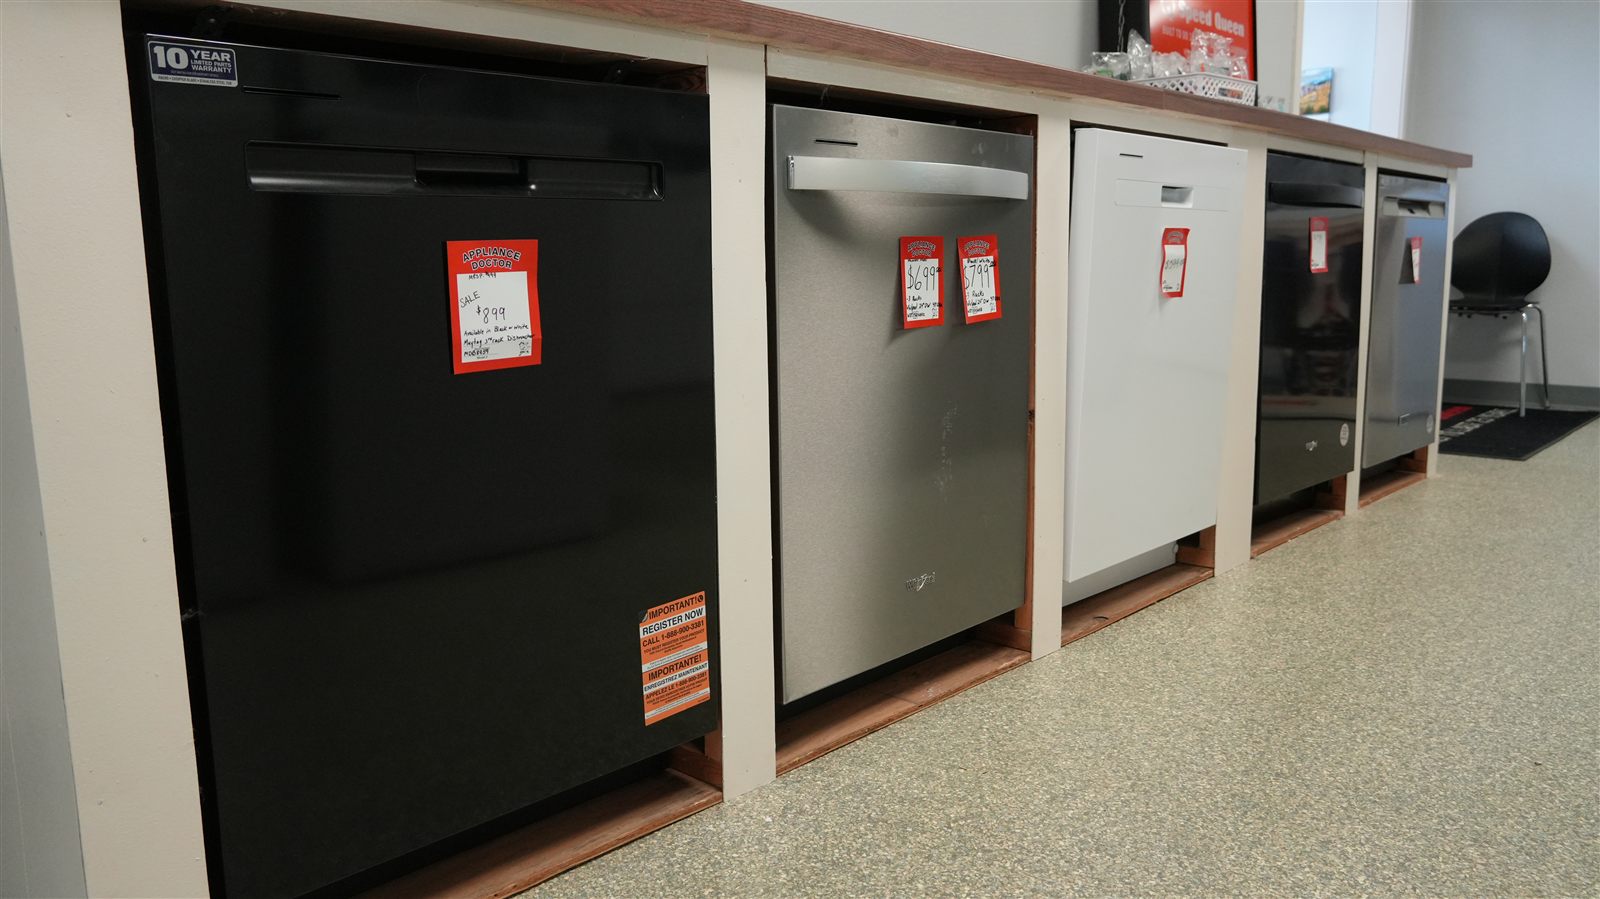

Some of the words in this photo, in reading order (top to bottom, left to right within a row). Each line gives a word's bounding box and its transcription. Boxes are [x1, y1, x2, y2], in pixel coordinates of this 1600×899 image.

[1214, 11, 1245, 38] Queen
[153, 45, 189, 70] 10
[190, 49, 231, 62] YEAR
[190, 59, 213, 67] LIMITED
[191, 64, 232, 74] WARRANTY
[907, 240, 937, 253] APPLIANCE
[463, 246, 521, 263] APPLIANCE
[471, 258, 512, 270] DOCTOR
[460, 290, 480, 308] SALE
[476, 304, 506, 324] $899
[494, 325, 508, 333] Black
[464, 338, 482, 348] Maytag
[648, 595, 697, 620] IMPORTANT!
[642, 615, 683, 636] REGISTER
[684, 607, 704, 621] NOW
[642, 636, 659, 647] CALL
[648, 653, 702, 681] IMPORTANTE!
[644, 674, 678, 692] ENREGISTREZ
[677, 662, 708, 680] MAINTENANT
[645, 688, 667, 699] APPELEZ
